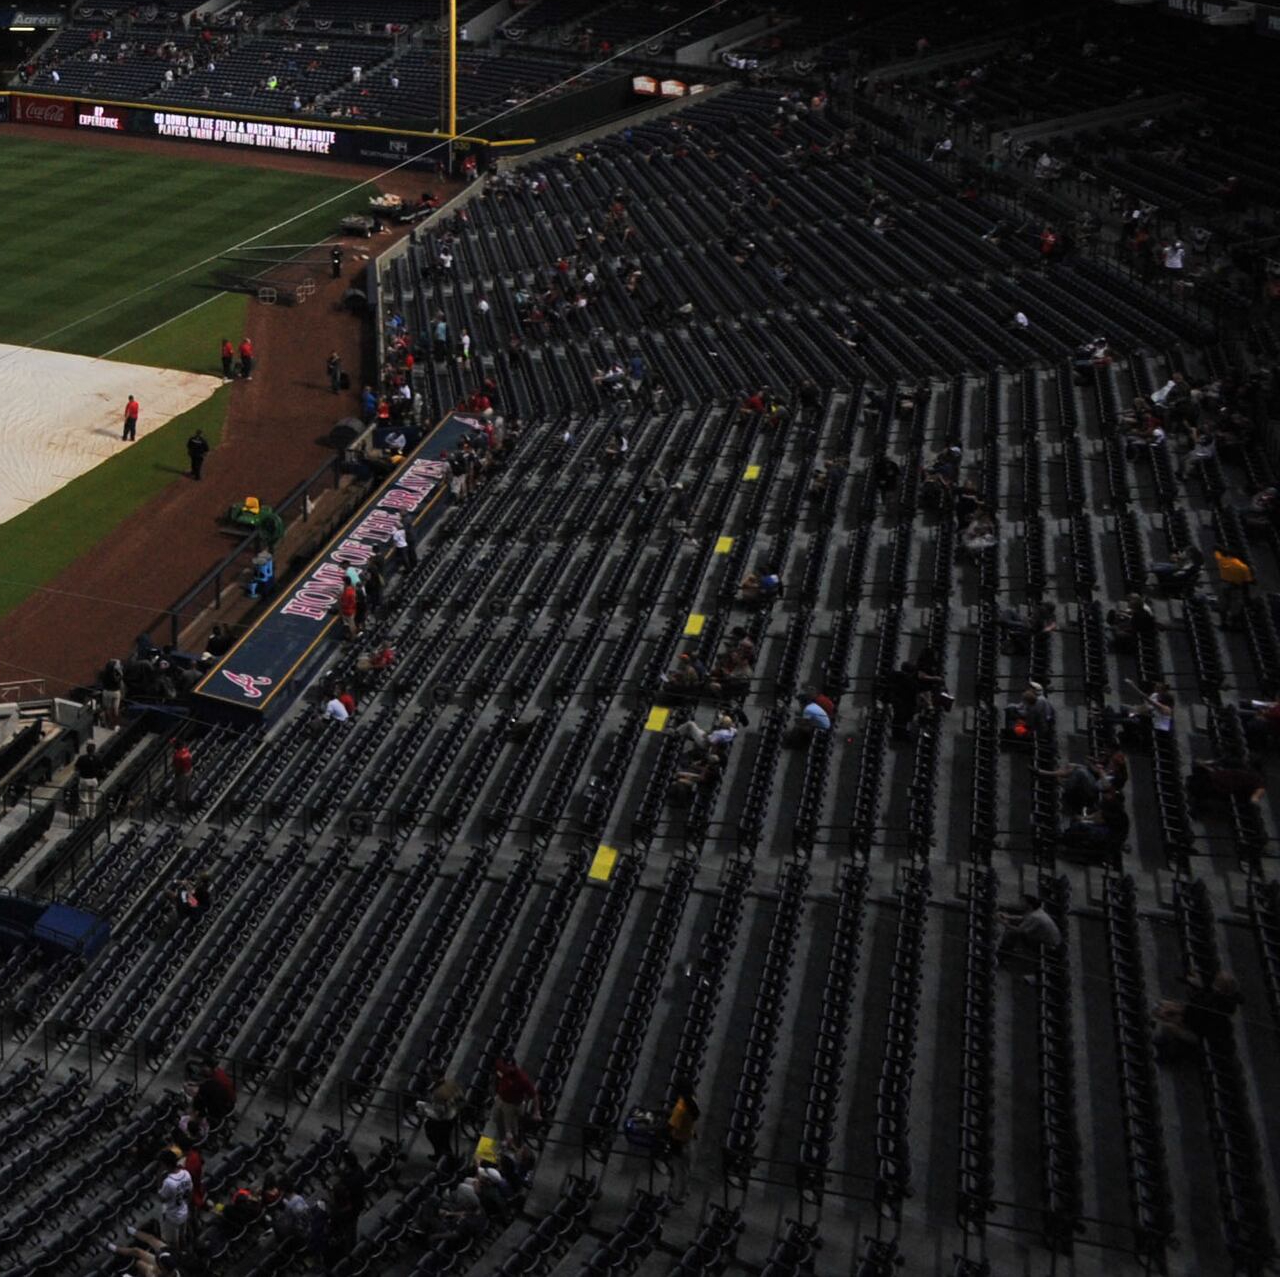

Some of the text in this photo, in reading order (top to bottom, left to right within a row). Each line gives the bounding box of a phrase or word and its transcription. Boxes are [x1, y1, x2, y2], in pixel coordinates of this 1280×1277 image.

[79, 114, 119, 129] EXPERIENCE
[154, 112, 335, 143] GO DOWN ON THE FIELD WATCH YOUR FAVORITE
[158, 124, 330, 154] PLAYERS WARM UP DURING BATTING PRACTICE
[280, 458, 450, 621] HOME OF THE BRAVES
